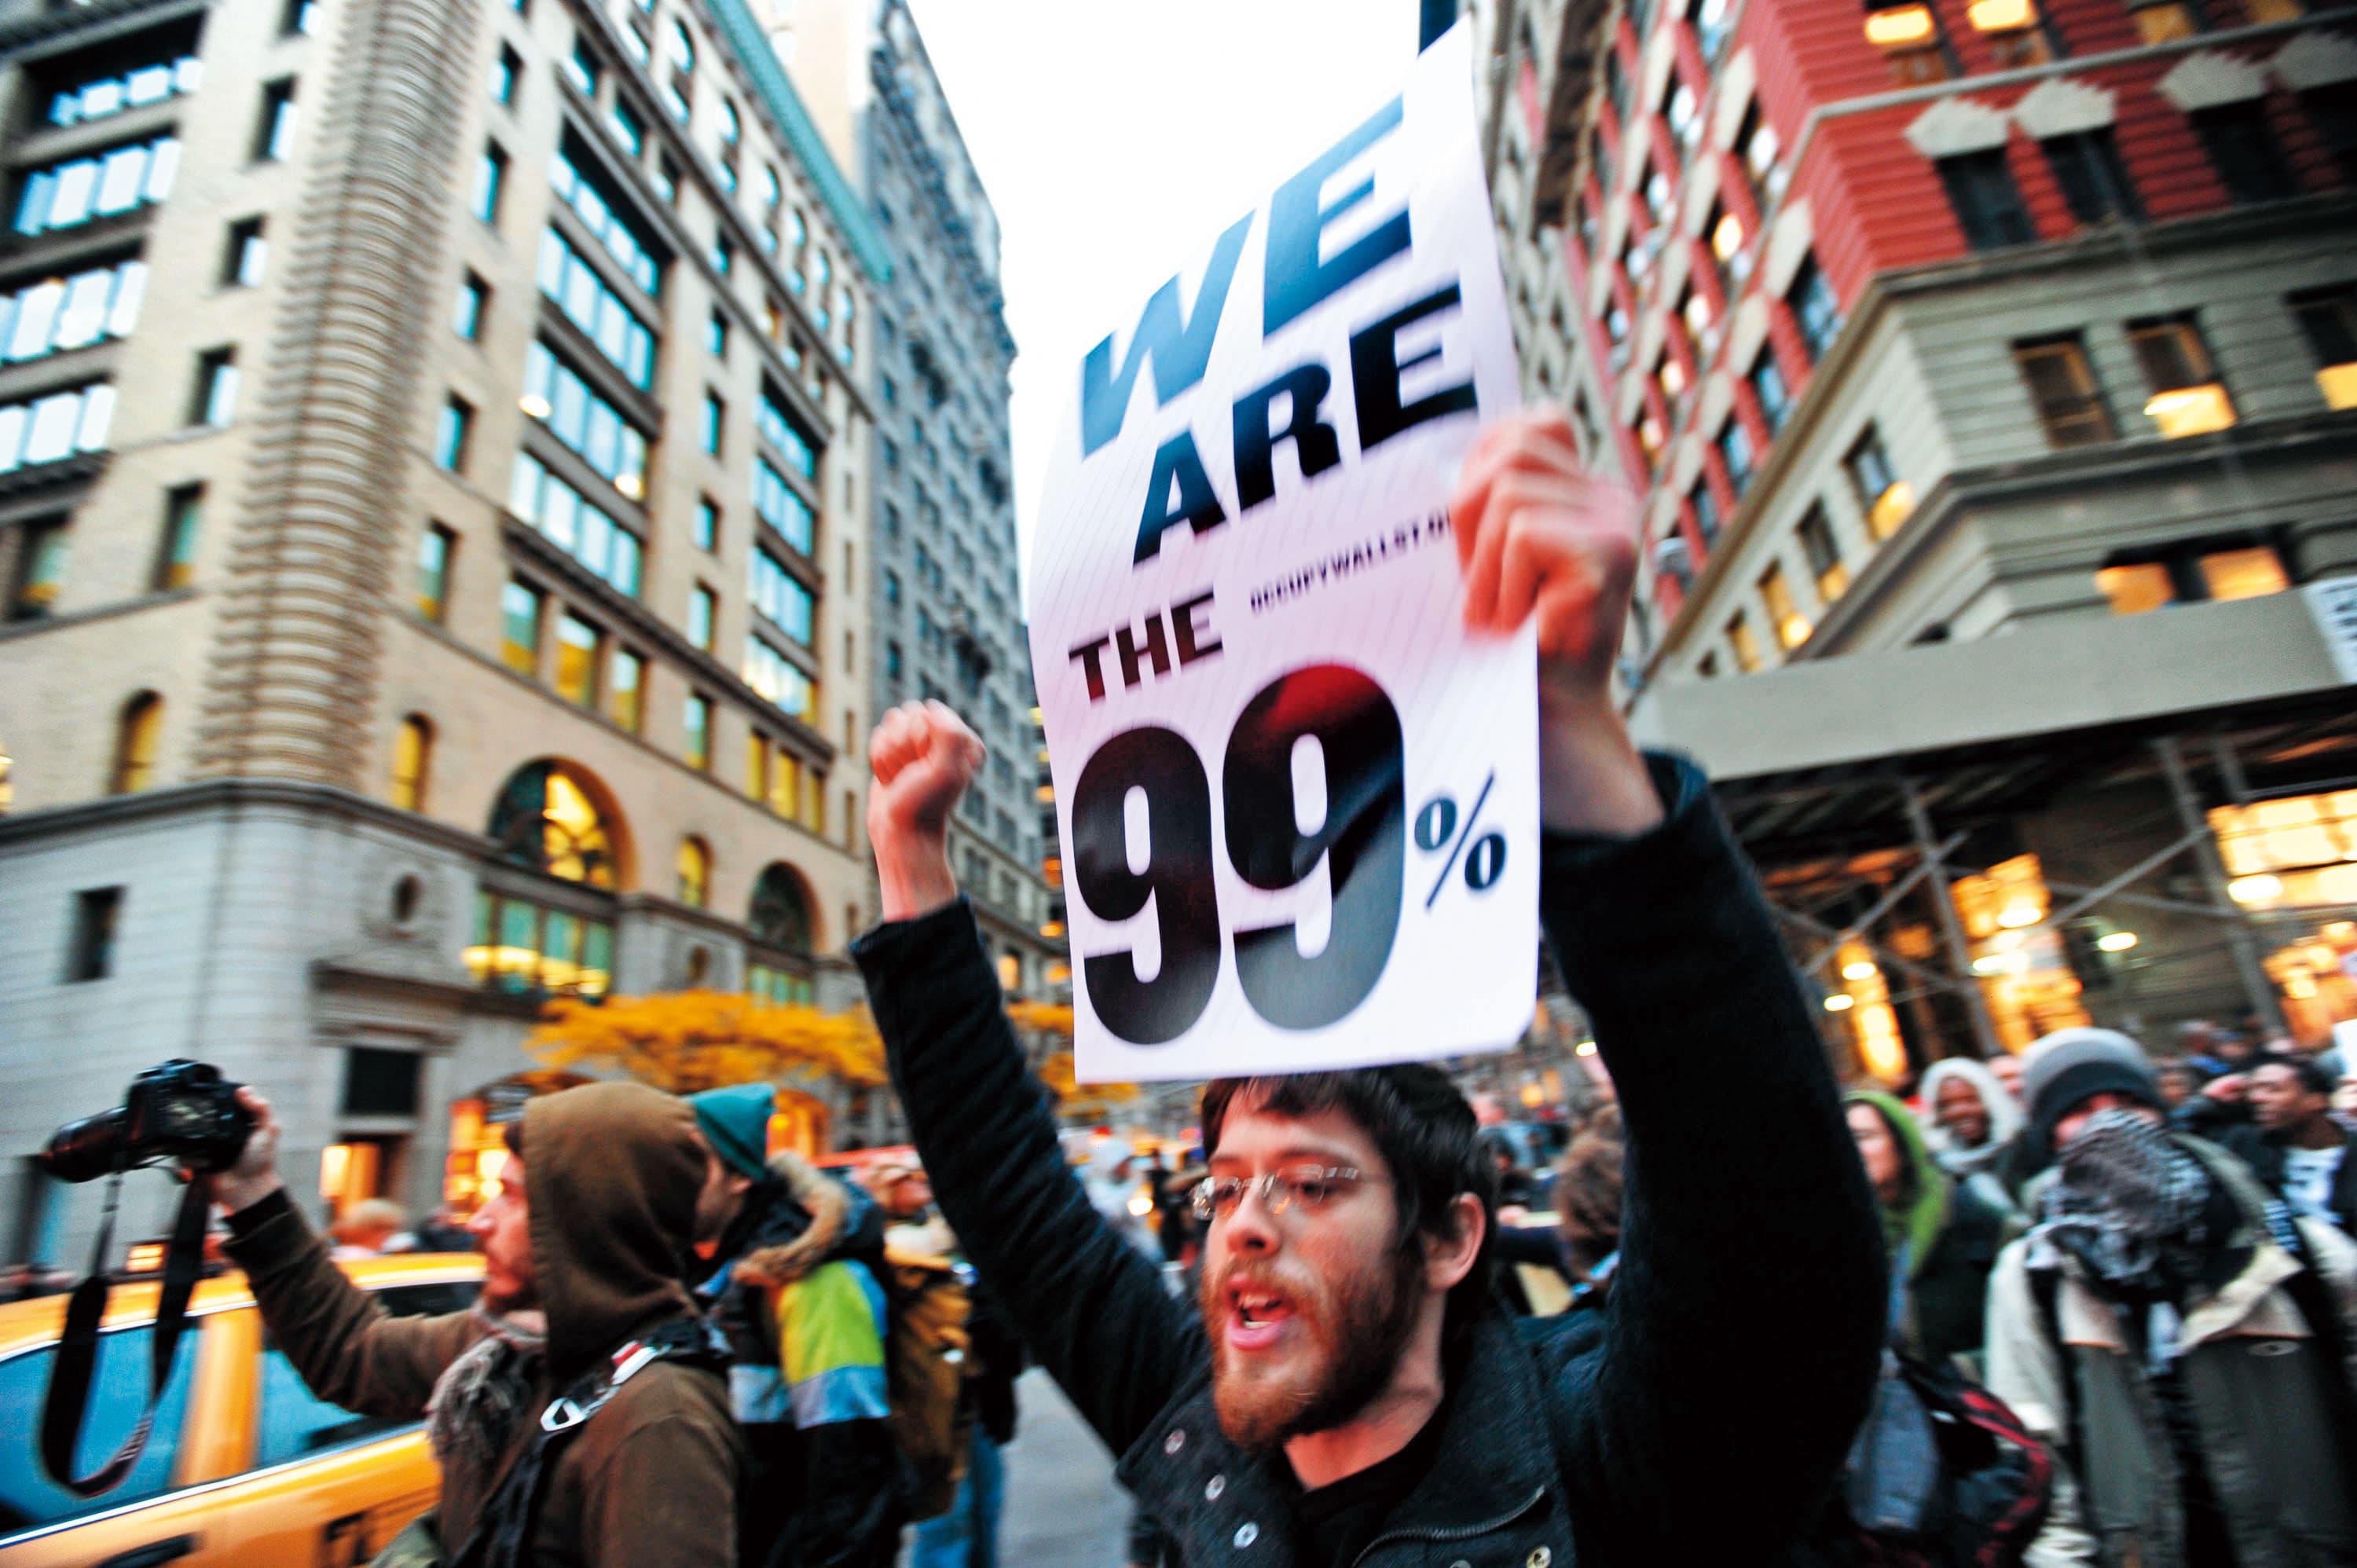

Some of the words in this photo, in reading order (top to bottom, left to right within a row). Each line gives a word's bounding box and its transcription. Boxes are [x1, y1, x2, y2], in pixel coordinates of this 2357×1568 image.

[1081, 91, 1413, 462] WE
[1132, 282, 1479, 571] ARE
[1069, 592, 1223, 707] THE
